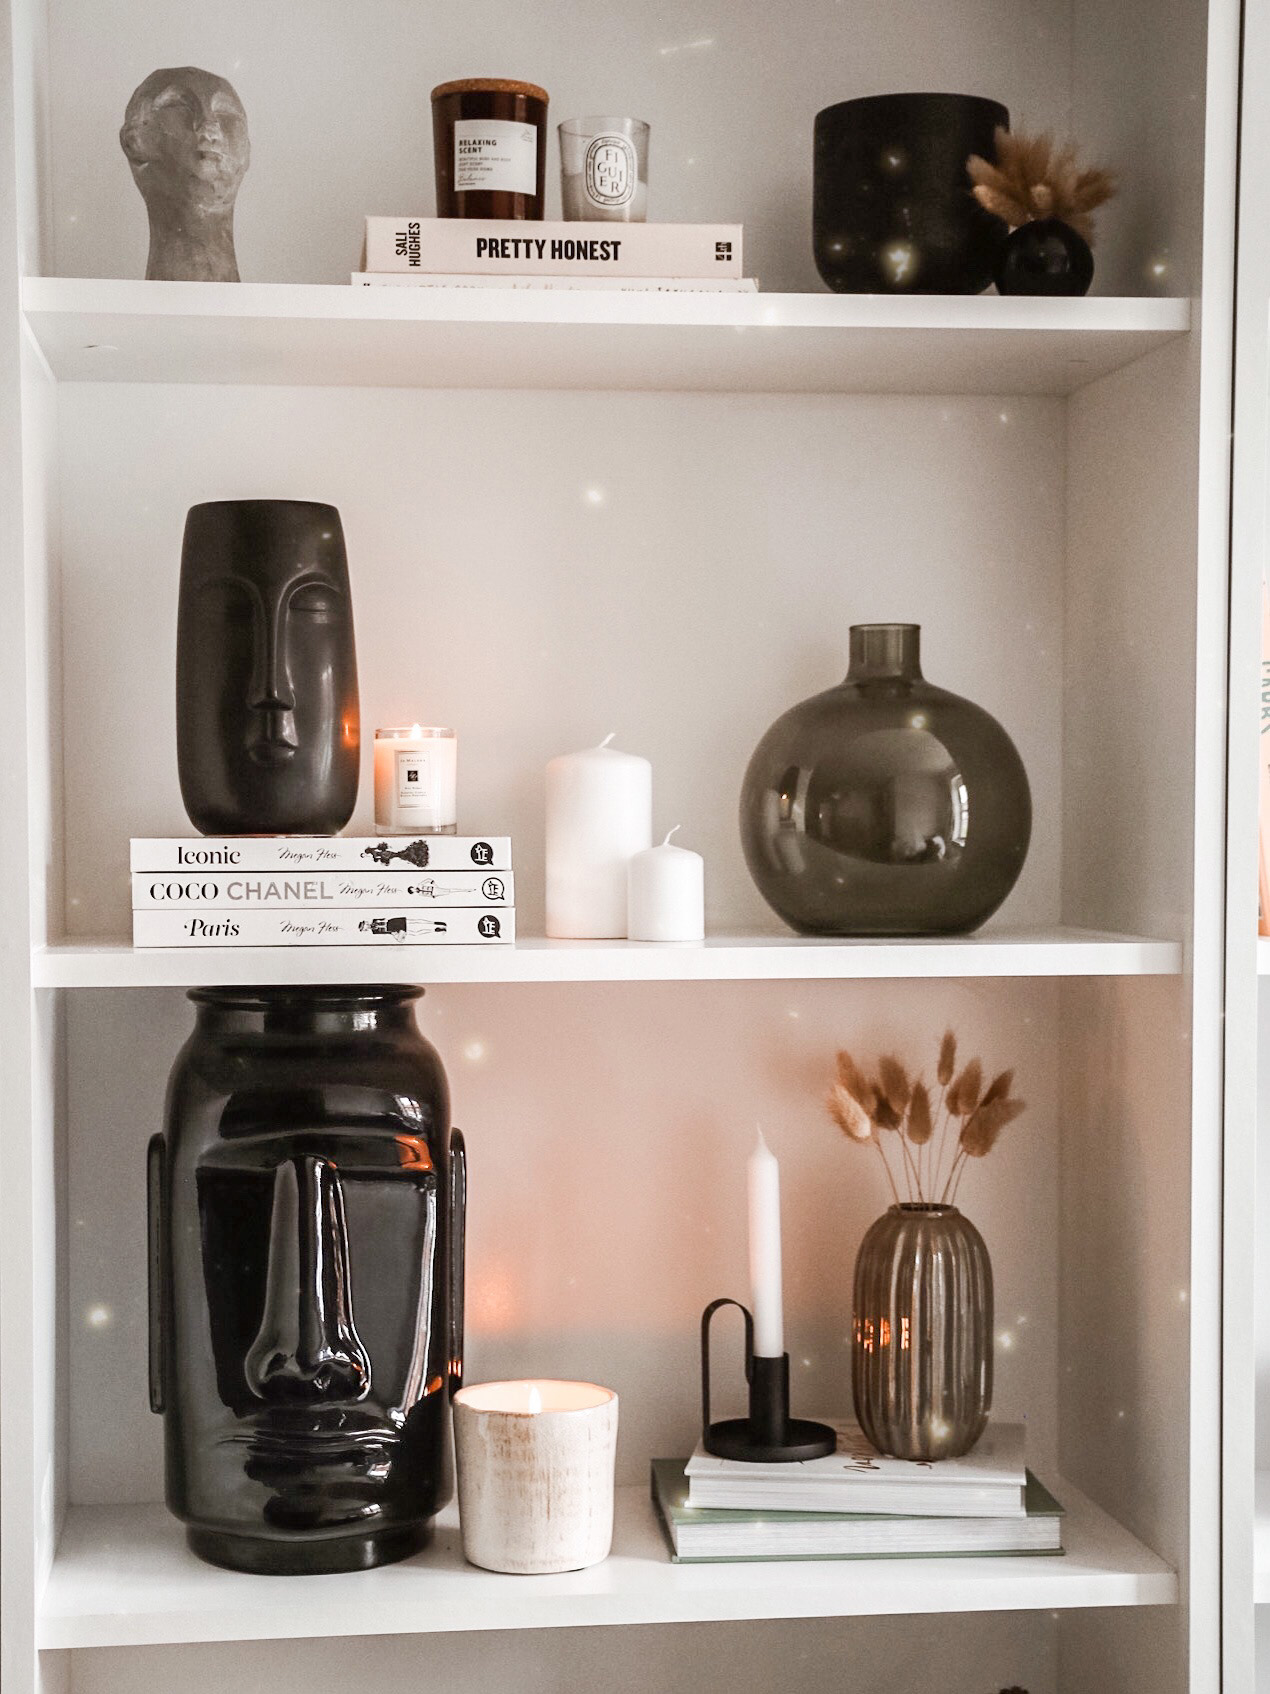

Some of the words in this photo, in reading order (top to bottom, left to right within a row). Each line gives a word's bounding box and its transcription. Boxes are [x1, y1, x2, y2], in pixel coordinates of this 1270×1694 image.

[458, 139, 498, 147] RELAXING
[458, 146, 483, 154] SCENT
[395, 232, 408, 256] SALI
[408, 222, 421, 267] HUGHES
[476, 237, 547, 259] PRETTY
[551, 239, 622, 261] HONEST
[177, 845, 241, 865] Iconic
[149, 882, 219, 901] COCO
[226, 881, 334, 901] CHANEL
[183, 918, 241, 937] Paris
